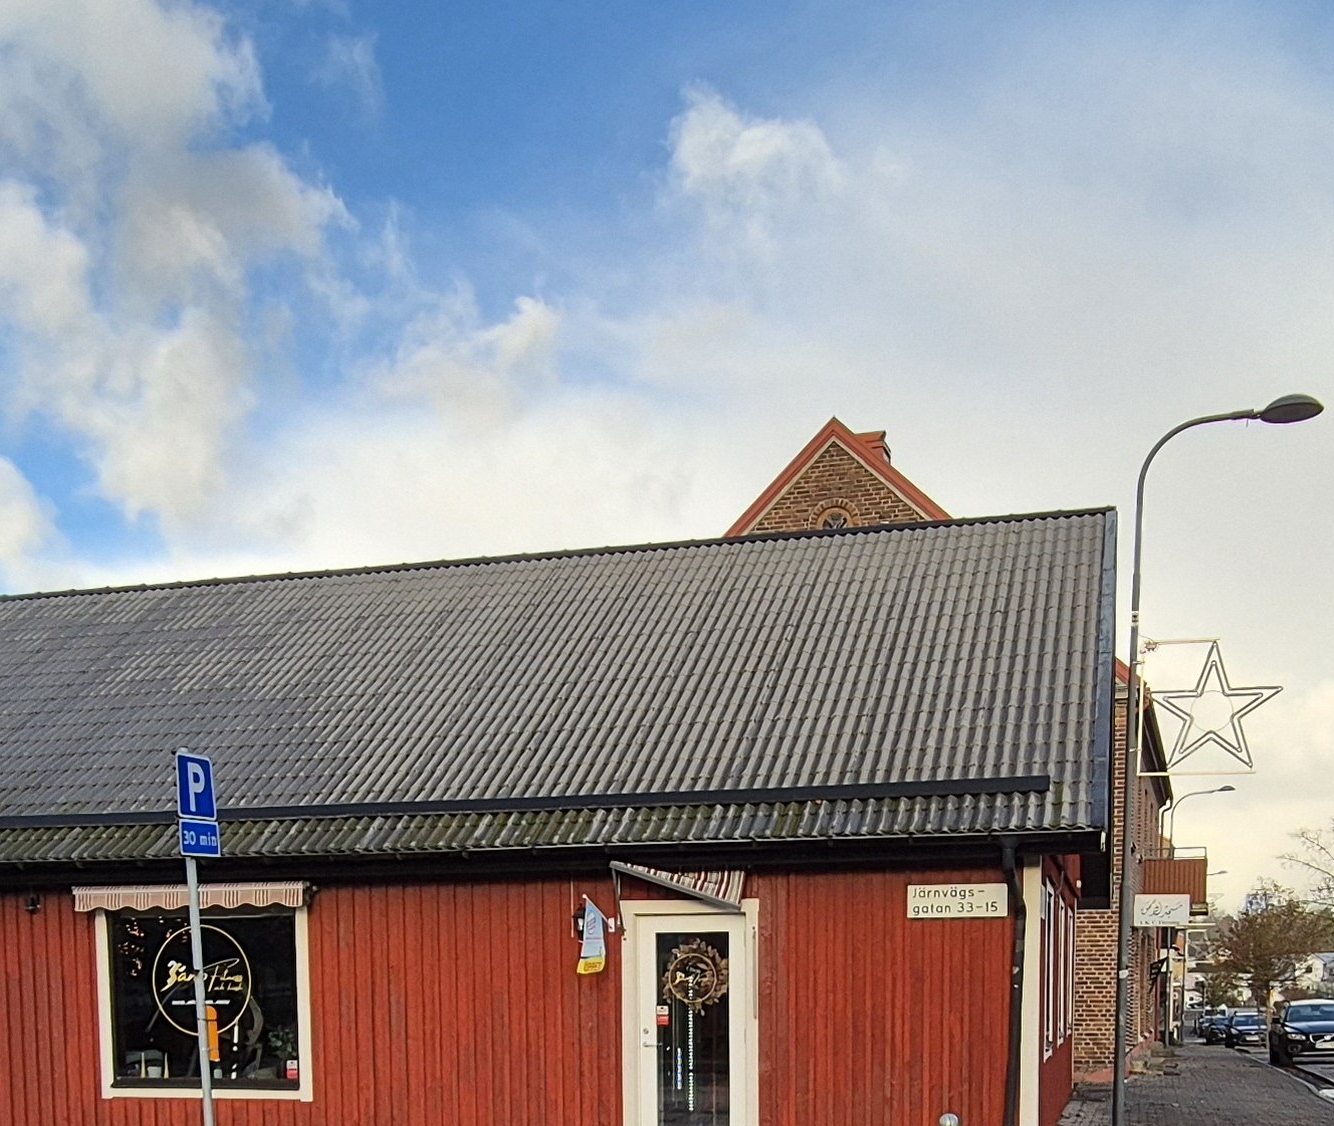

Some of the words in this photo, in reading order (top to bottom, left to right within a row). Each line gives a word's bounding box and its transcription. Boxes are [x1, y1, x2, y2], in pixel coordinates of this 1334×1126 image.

[187, 761, 205, 812] P
[183, 831, 196, 846] 30
[199, 832, 217, 846] min
[912, 886, 985, 900] Järnvägs-
[912, 903, 951, 916] gatan
[957, 901, 998, 913] 33-15
